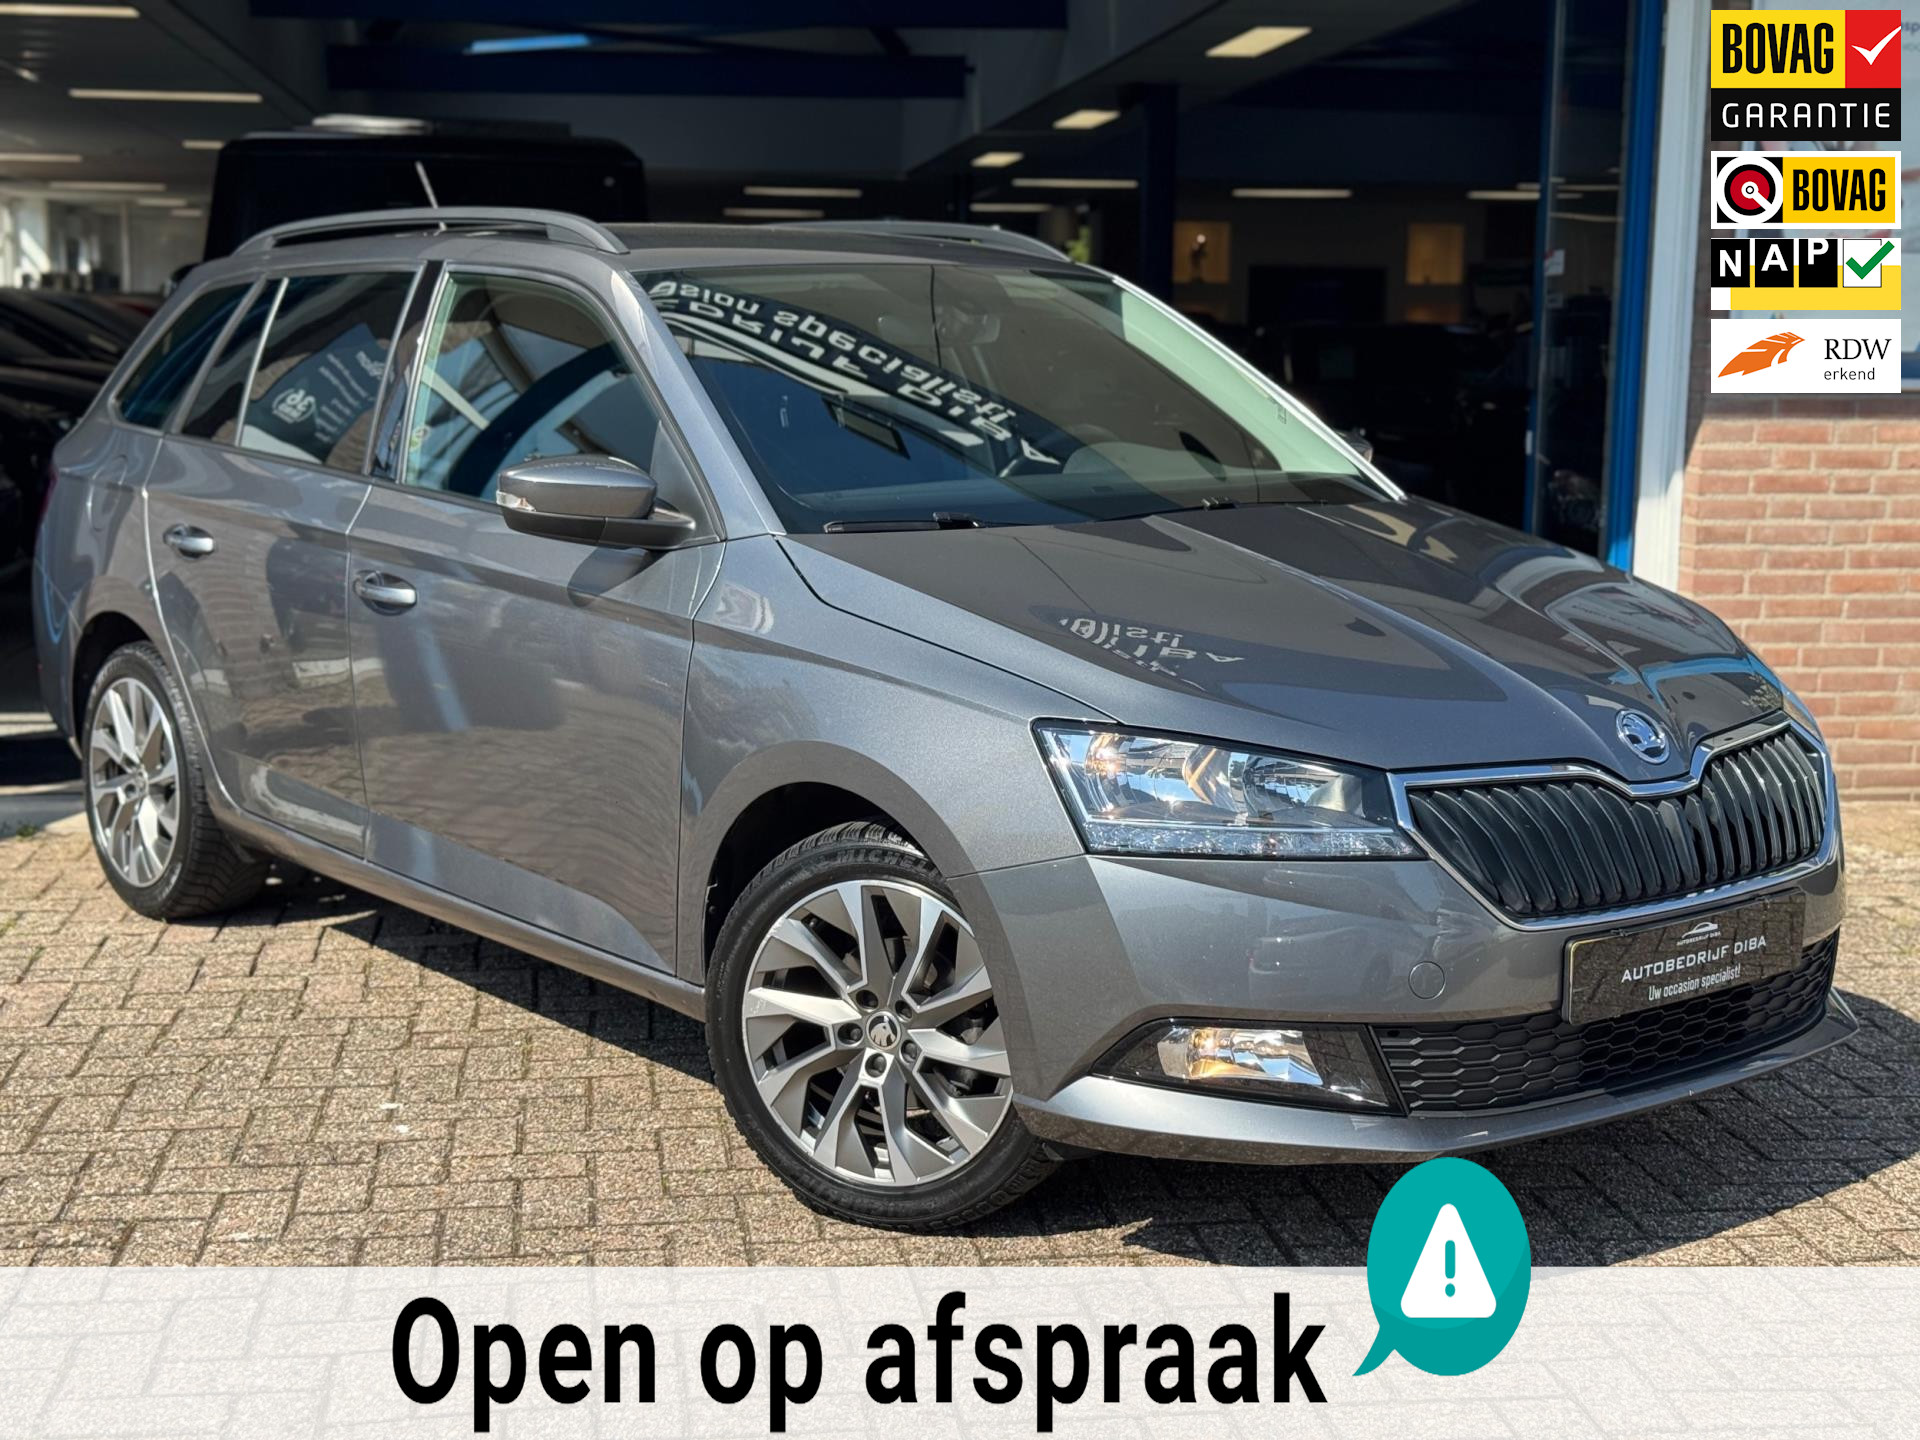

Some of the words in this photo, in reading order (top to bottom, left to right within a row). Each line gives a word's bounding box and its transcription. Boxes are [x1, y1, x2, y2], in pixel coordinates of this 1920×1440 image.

[1621, 944, 1730, 984] AUTOBEDRIJF
[1733, 935, 1767, 955] DIBA
[1648, 985, 1662, 1001] Uw
[1663, 976, 1700, 998] occasion
[1700, 963, 1741, 989] specialist!
